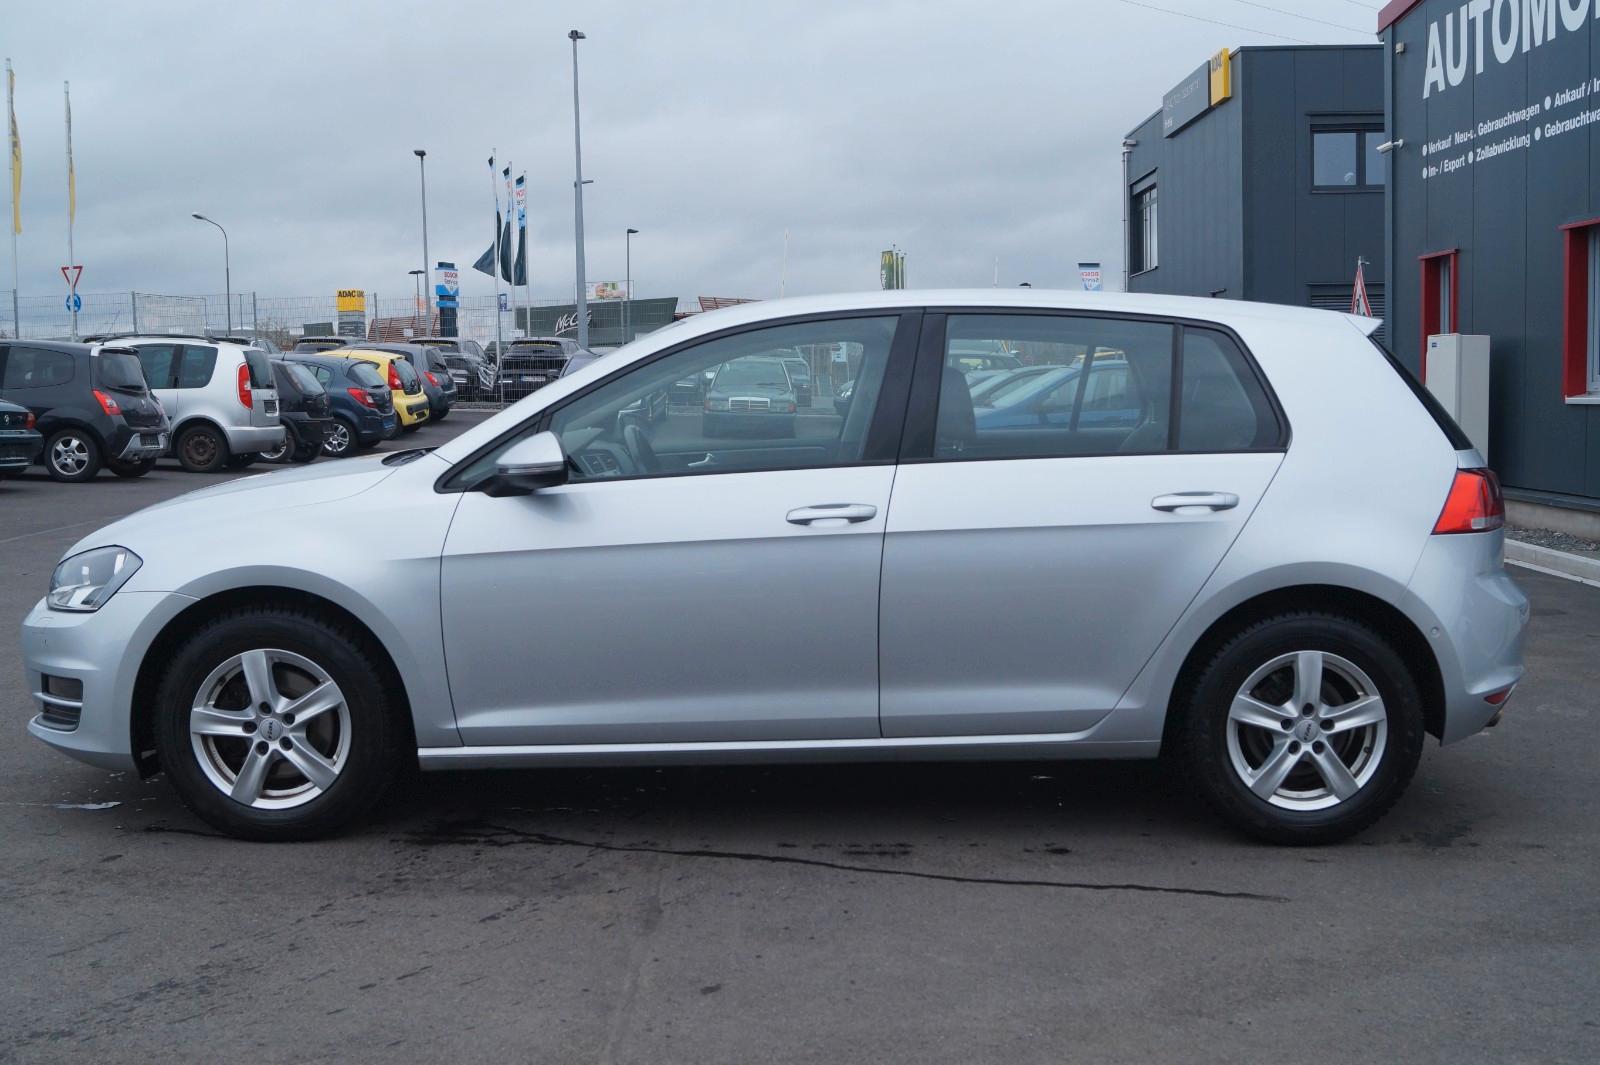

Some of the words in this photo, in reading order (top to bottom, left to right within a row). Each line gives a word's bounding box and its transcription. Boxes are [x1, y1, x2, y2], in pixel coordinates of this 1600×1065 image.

[1428, 134, 1452, 154] Verkauf
[1477, 103, 1540, 136] Gebrauchtwagen
[1554, 82, 1586, 108] Ankauf
[1443, 154, 1466, 173] Export
[1475, 133, 1531, 162] Zollabwicklung
[337, 290, 356, 298] ADAC
